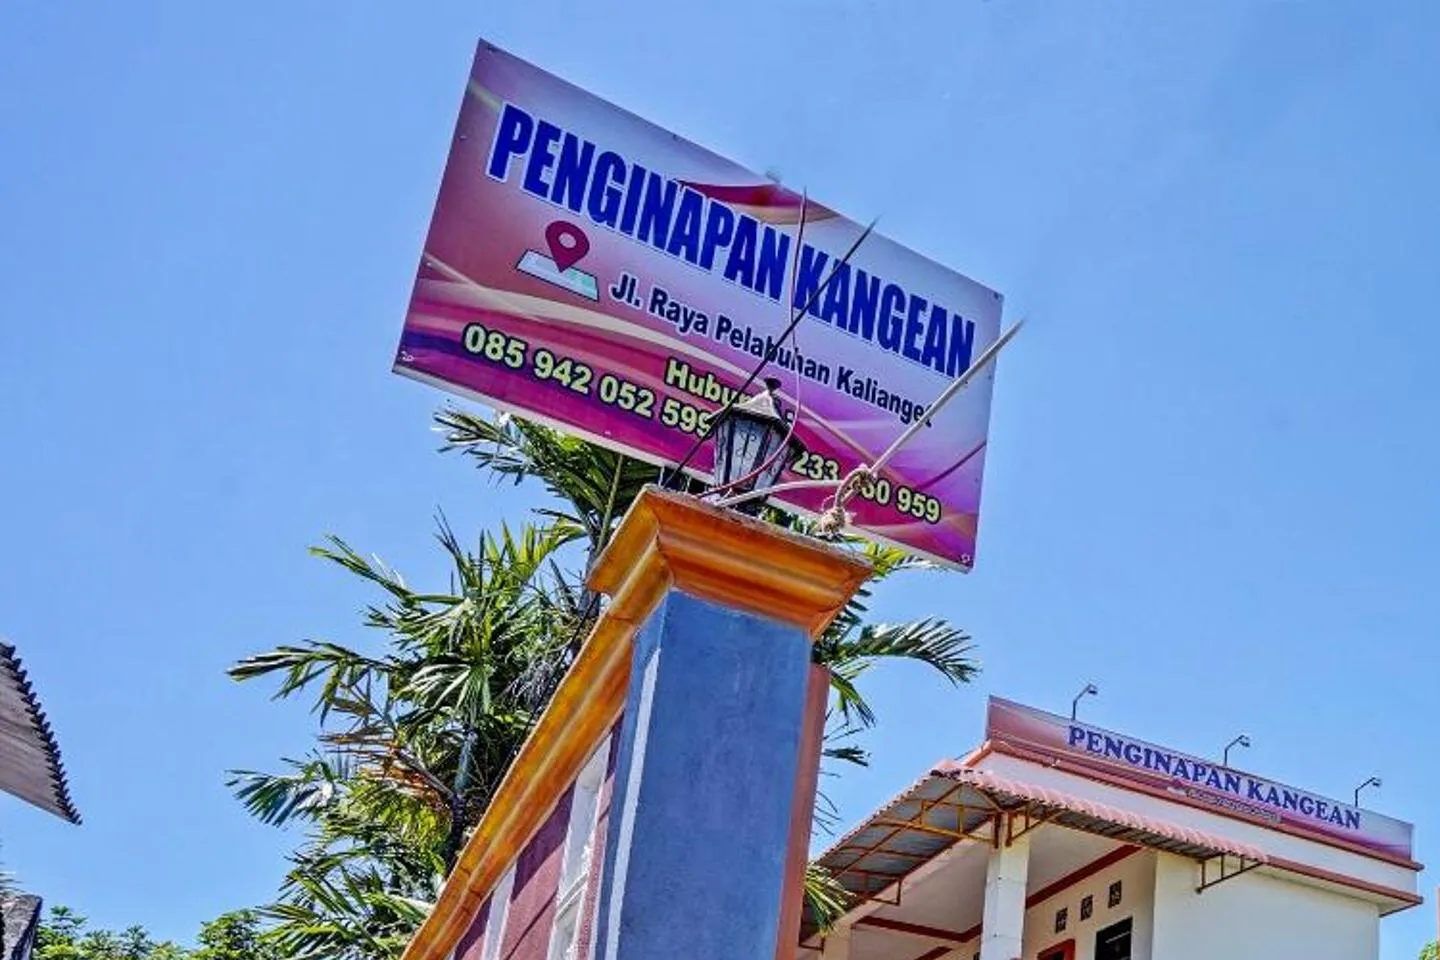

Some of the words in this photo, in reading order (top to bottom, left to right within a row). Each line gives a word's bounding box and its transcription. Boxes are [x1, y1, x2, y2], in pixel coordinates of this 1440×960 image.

[488, 103, 790, 300] PENGINAPAN
[793, 243, 975, 378] KANGEAN
[611, 274, 640, 306] Jl.
[650, 288, 708, 334] Raya
[716, 315, 830, 384] Pelabuhan
[464, 325, 525, 368] 085
[534, 351, 593, 394] 942
[600, 376, 655, 417] 052
[791, 451, 839, 481] 233
[897, 487, 940, 522] 959
[1068, 725, 1240, 794] PENGINAPAN
[1247, 779, 1360, 829] KANGEAN
